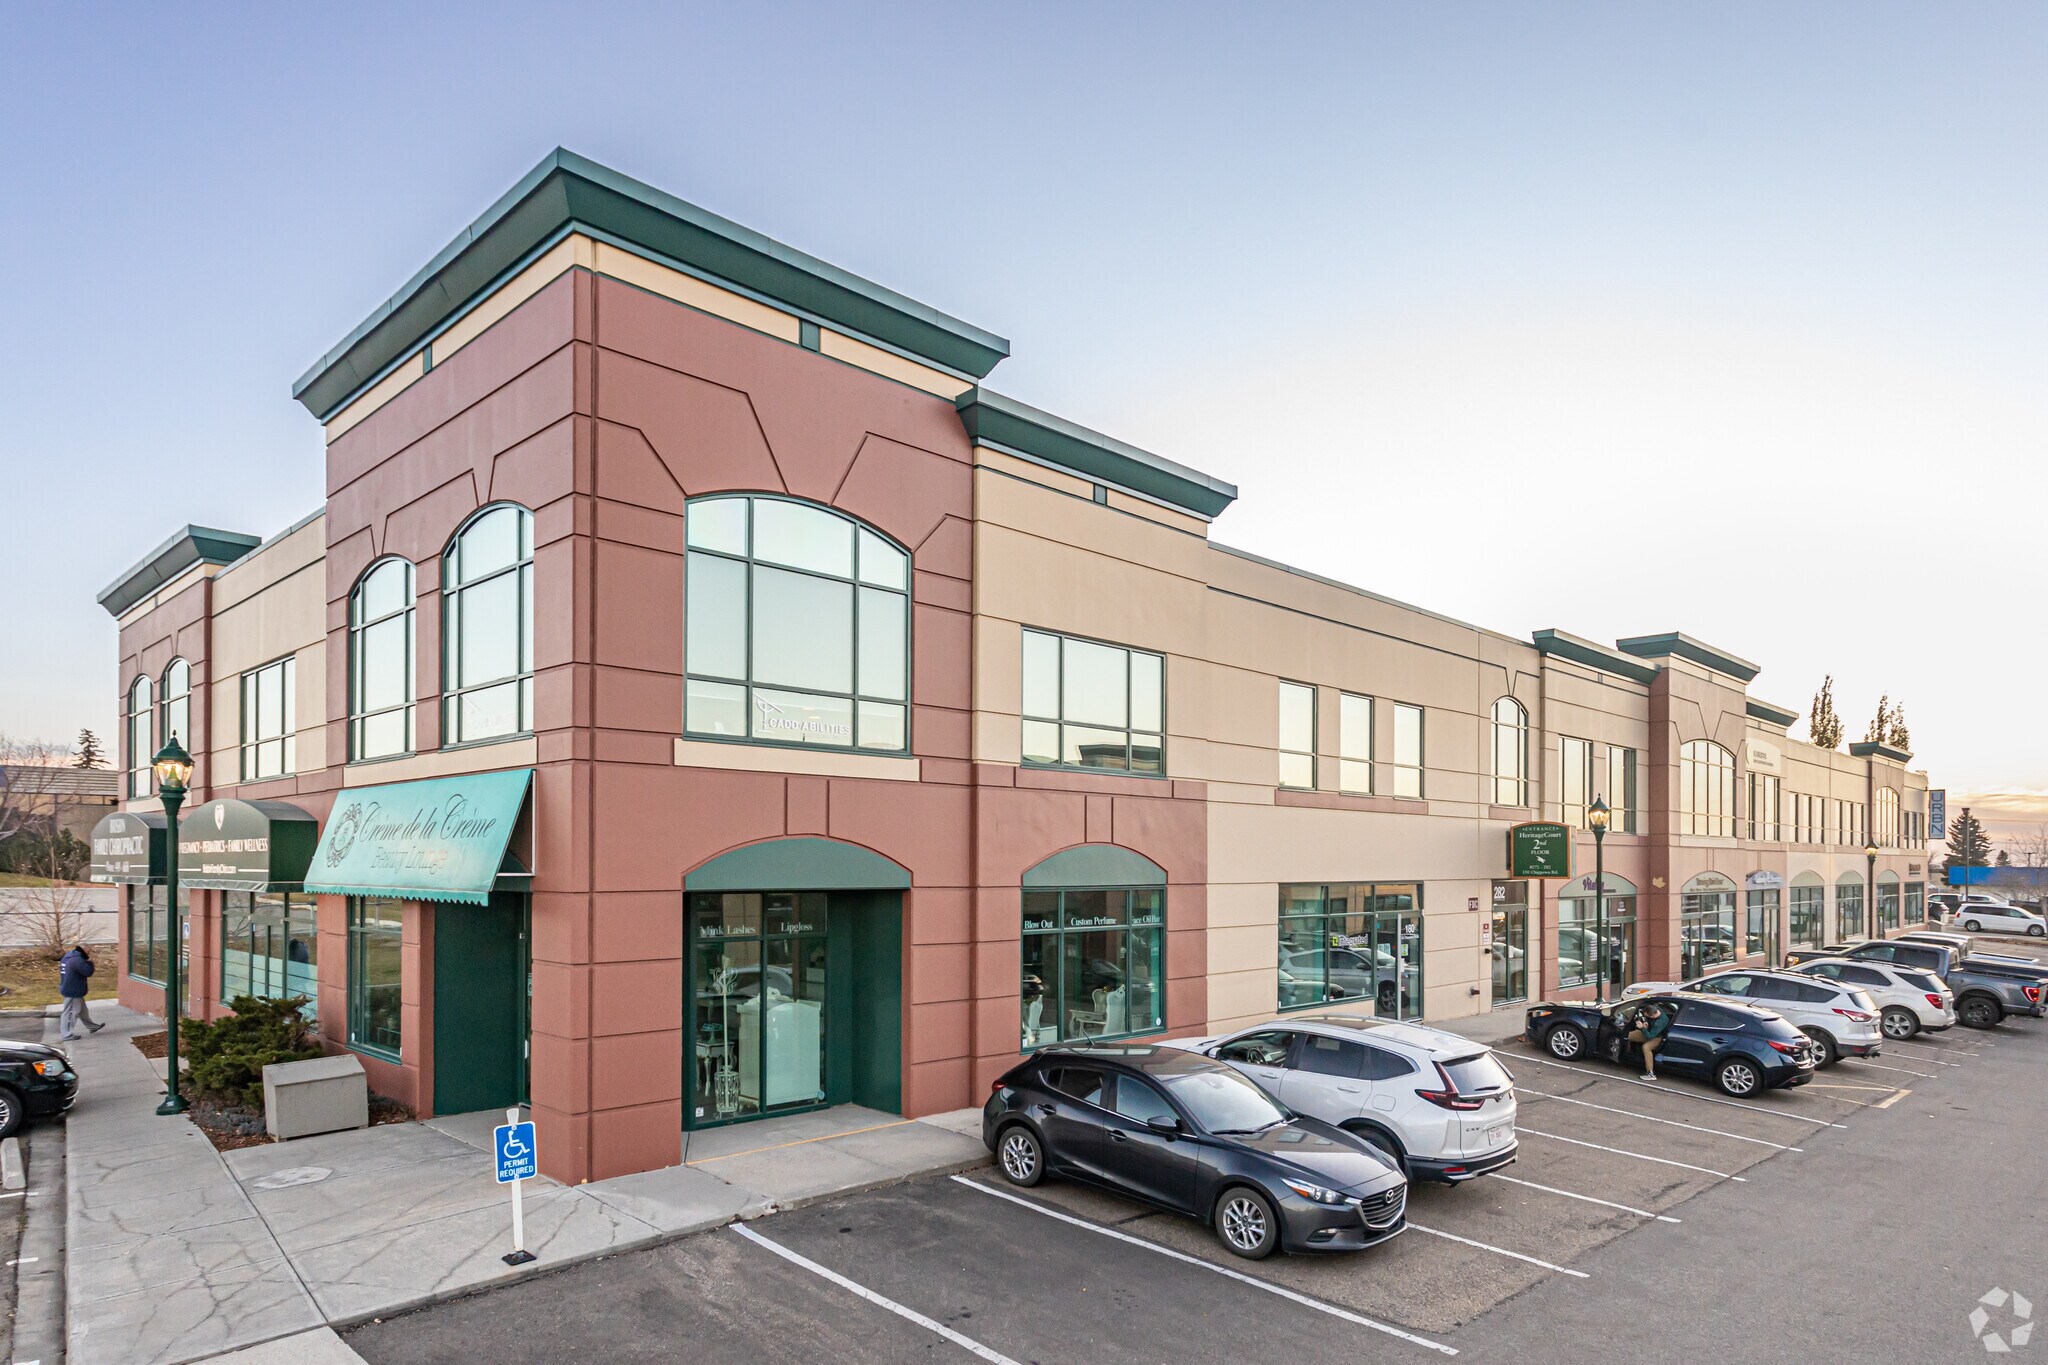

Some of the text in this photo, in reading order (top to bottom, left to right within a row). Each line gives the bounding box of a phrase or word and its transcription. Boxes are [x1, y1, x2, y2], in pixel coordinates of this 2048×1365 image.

[800, 721, 851, 735] ABILITIES
[1931, 792, 1943, 834] URBN
[401, 808, 421, 841] de
[419, 807, 438, 840] la
[1493, 886, 1506, 899] 282
[1024, 919, 1053, 930] Blow Out
[1070, 917, 1093, 926] Custom
[727, 924, 756, 935] Lashes
[780, 922, 813, 934] Lipgloss
[503, 1157, 529, 1169] PERMIT
[499, 1165, 534, 1178] REQUIRED
